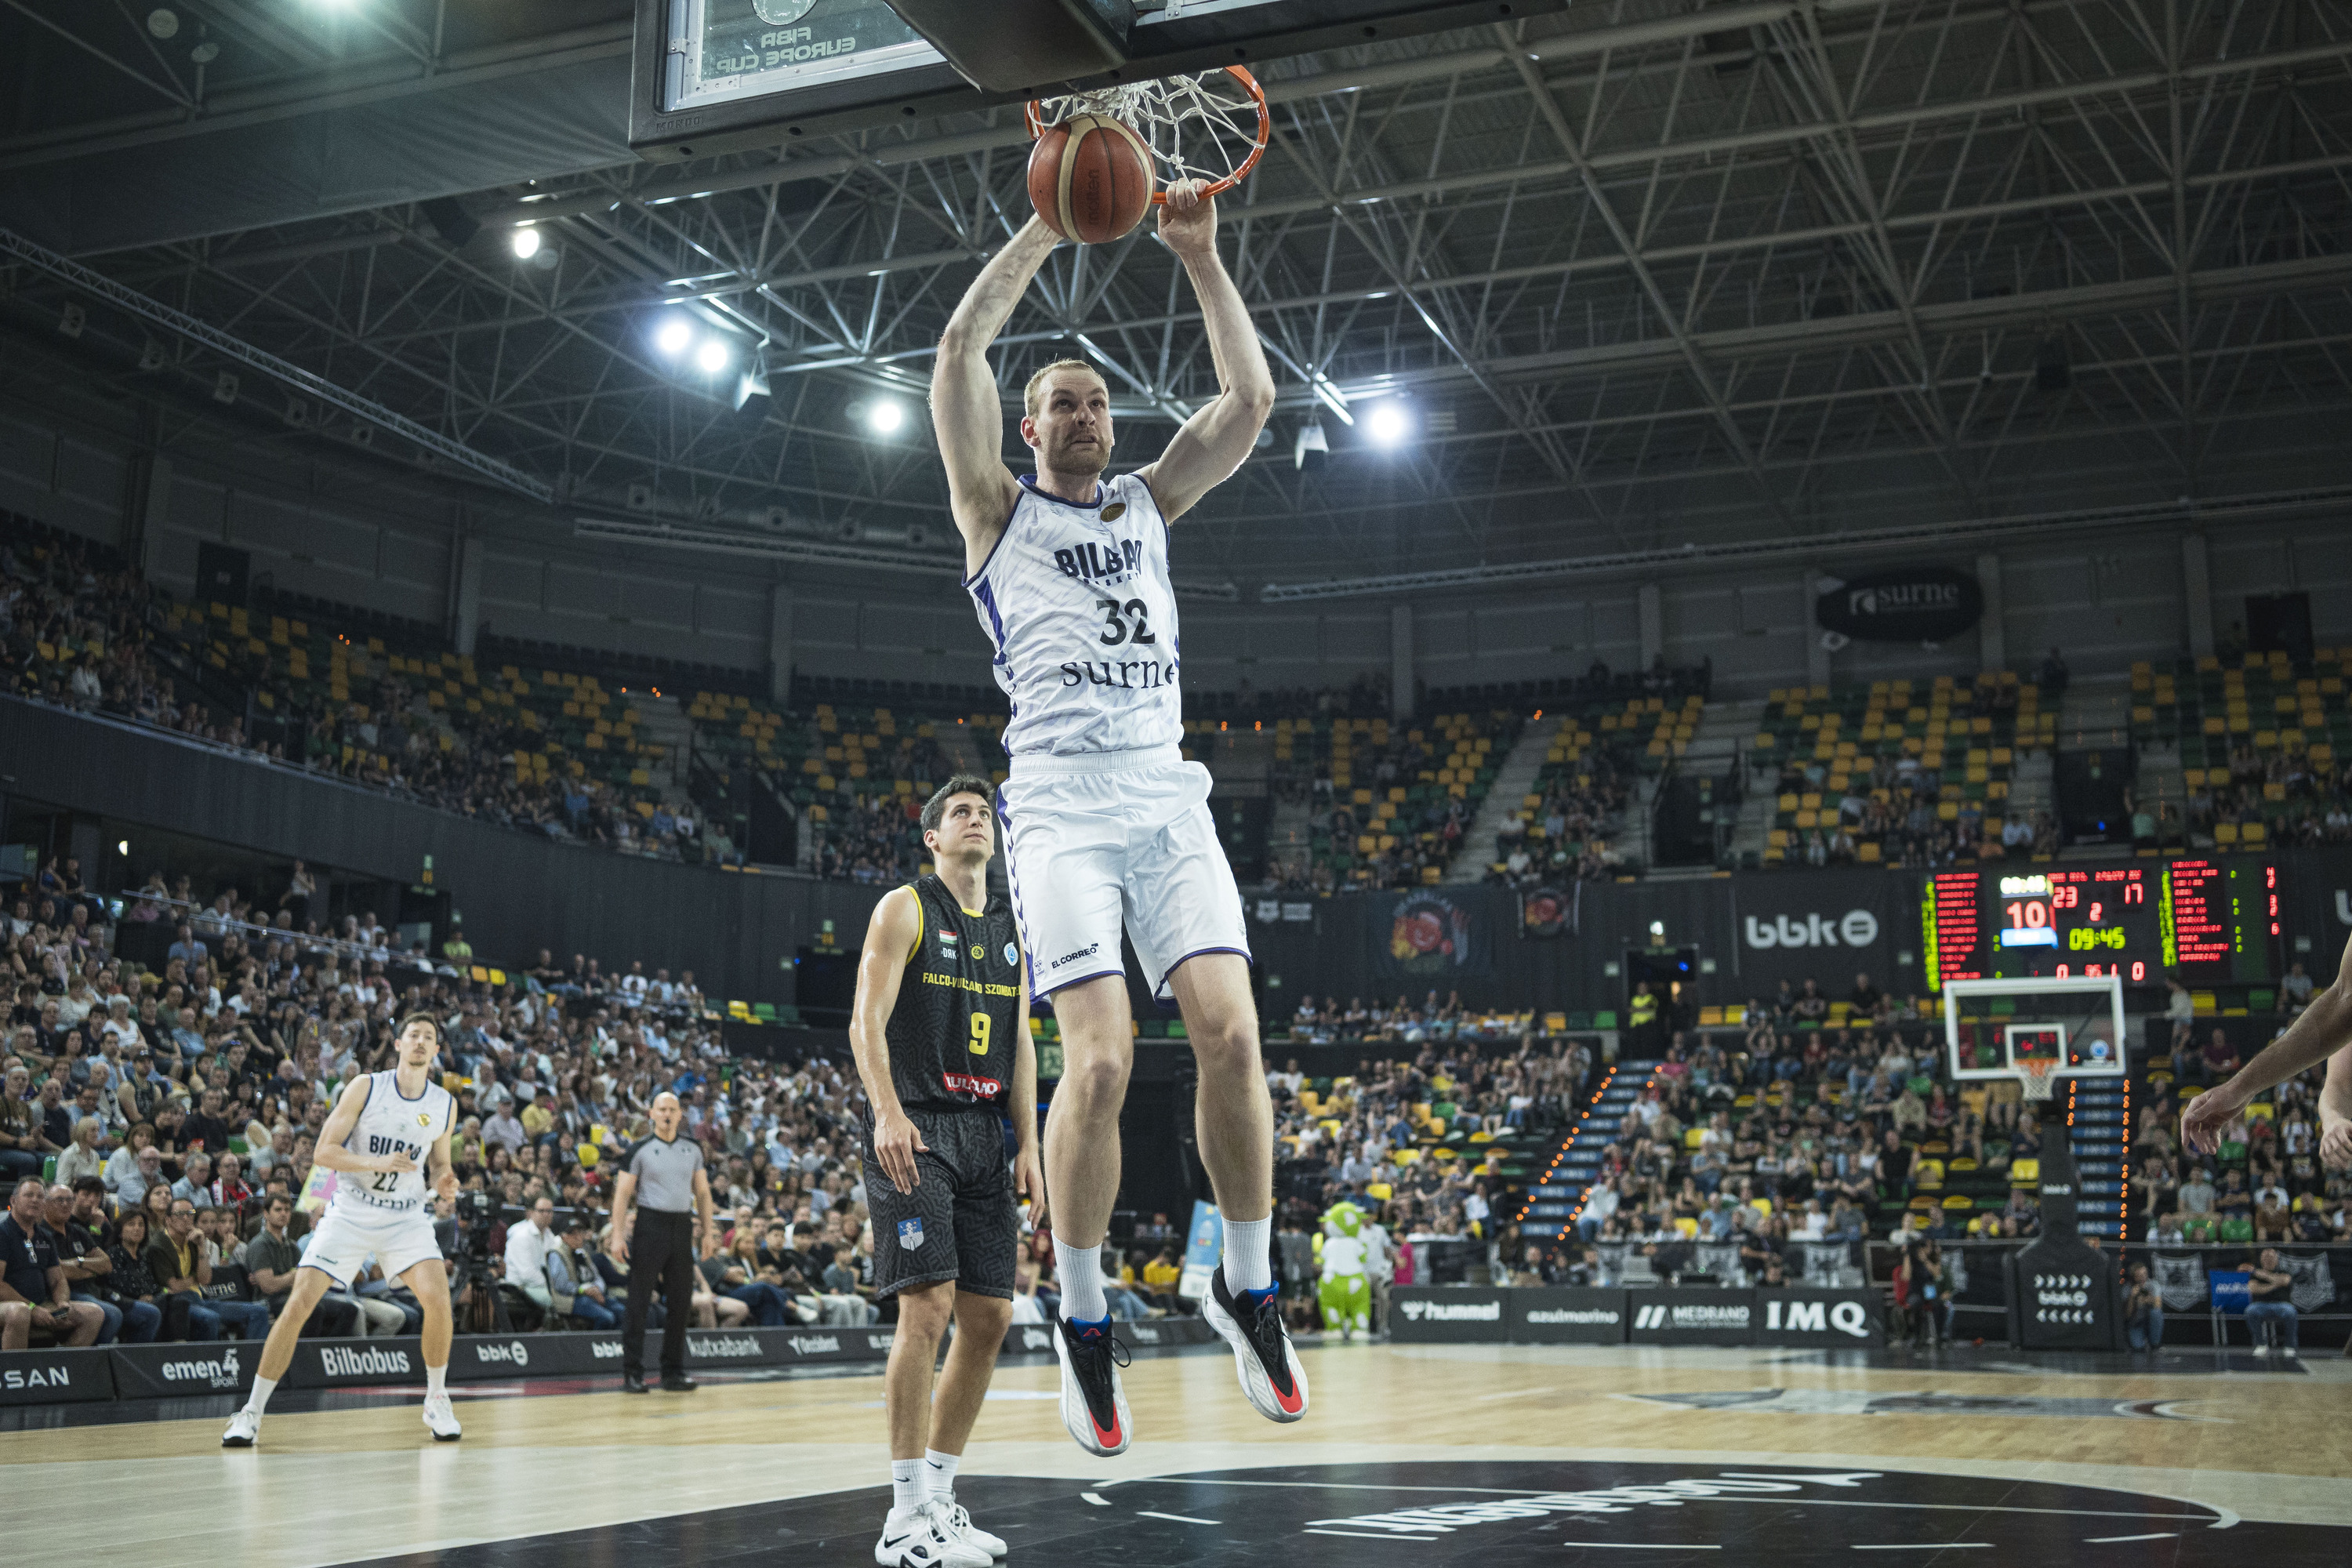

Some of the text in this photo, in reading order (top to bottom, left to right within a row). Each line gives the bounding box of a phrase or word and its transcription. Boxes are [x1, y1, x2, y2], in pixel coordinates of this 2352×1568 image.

[655, 117, 701, 133] MONDO
[1878, 583, 1959, 605] surne
[1096, 598, 1156, 645] 32
[1060, 660, 1175, 689] surne
[2052, 883, 2144, 909] 23 17
[2006, 900, 2047, 930] 10
[2089, 902, 2103, 921] 2
[2069, 926, 2125, 951] 09:45
[1051, 946, 1098, 969] EL CORREO
[968, 1011, 992, 1056] 9
[372, 1171, 399, 1192] 22
[198, 1280, 238, 1298] urne
[1671, 1305, 1750, 1322] MEDRANO
[1766, 1301, 1871, 1338] IMQ
[477, 1343, 514, 1363] bbk
[685, 1334, 764, 1358] kutxabank
[320, 1345, 411, 1377] Bilbobus
